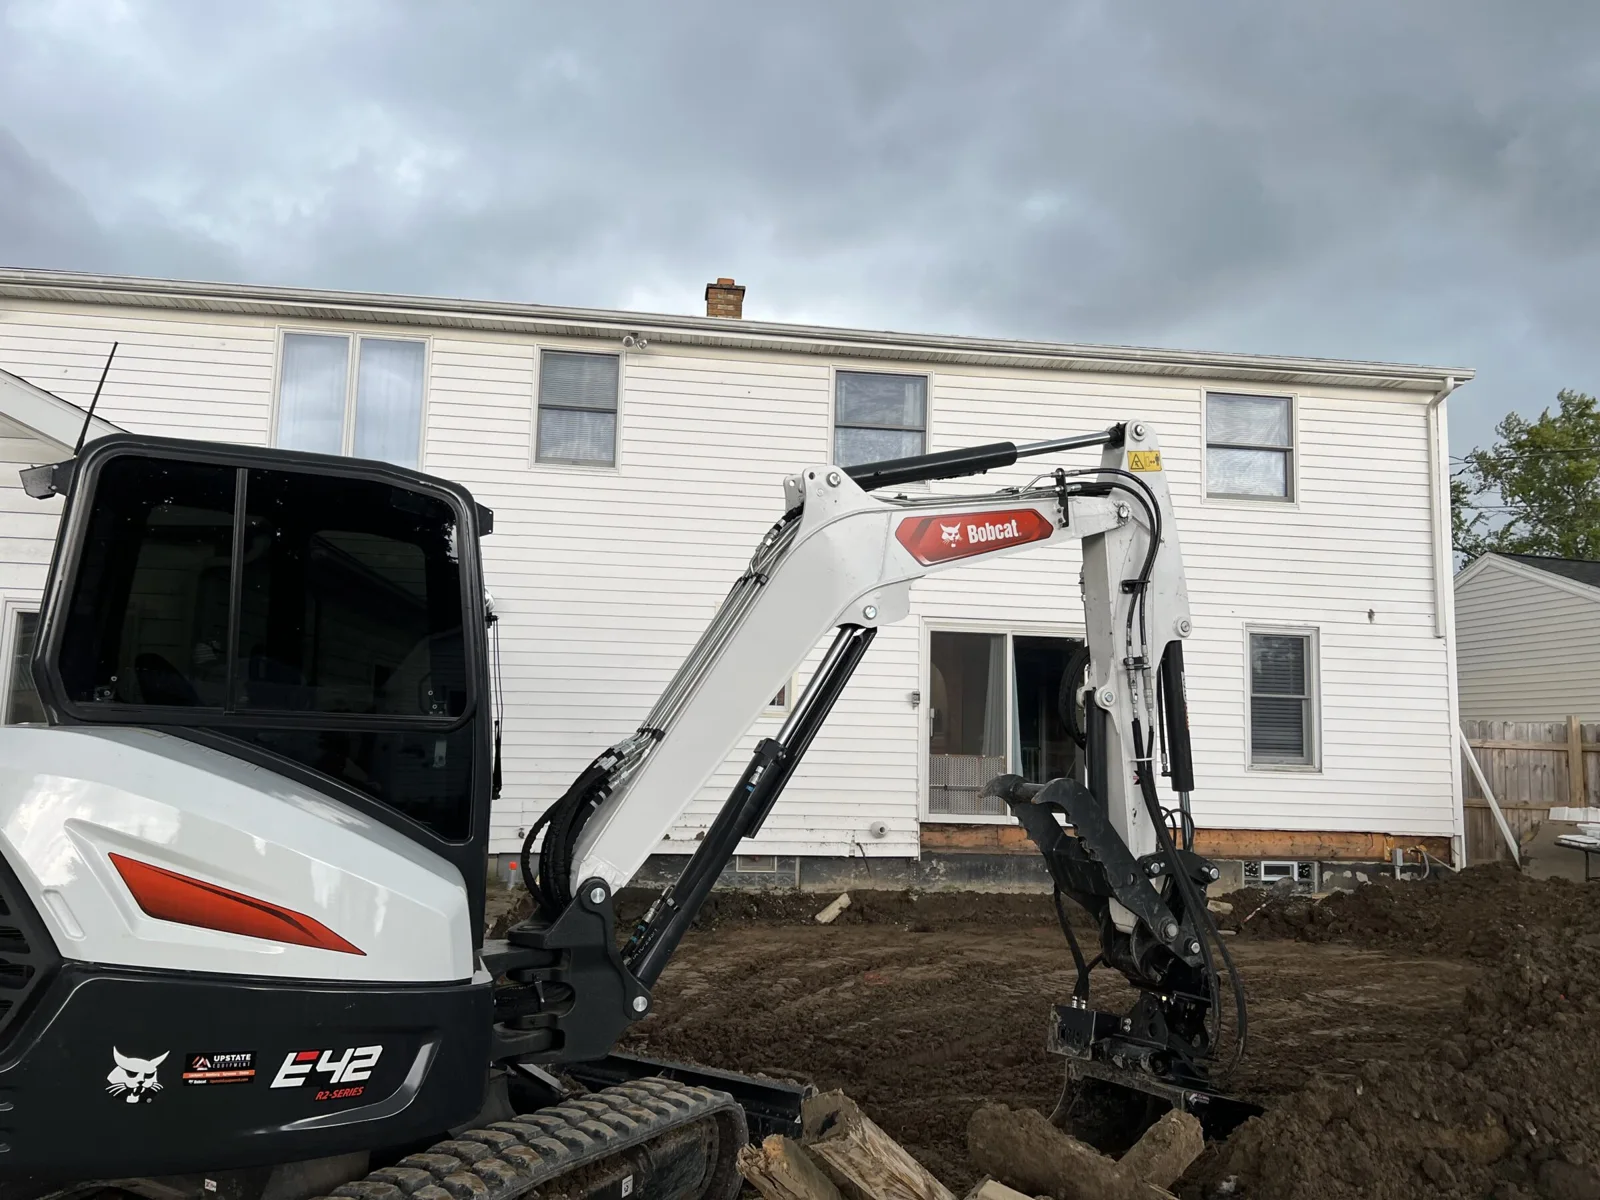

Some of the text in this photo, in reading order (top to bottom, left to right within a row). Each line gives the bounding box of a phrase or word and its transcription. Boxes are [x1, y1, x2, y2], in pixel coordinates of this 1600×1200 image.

[967, 519, 1018, 543] Bobcat
[270, 1045, 383, 1088] E42
[316, 1087, 364, 1101] R2-SERIES
